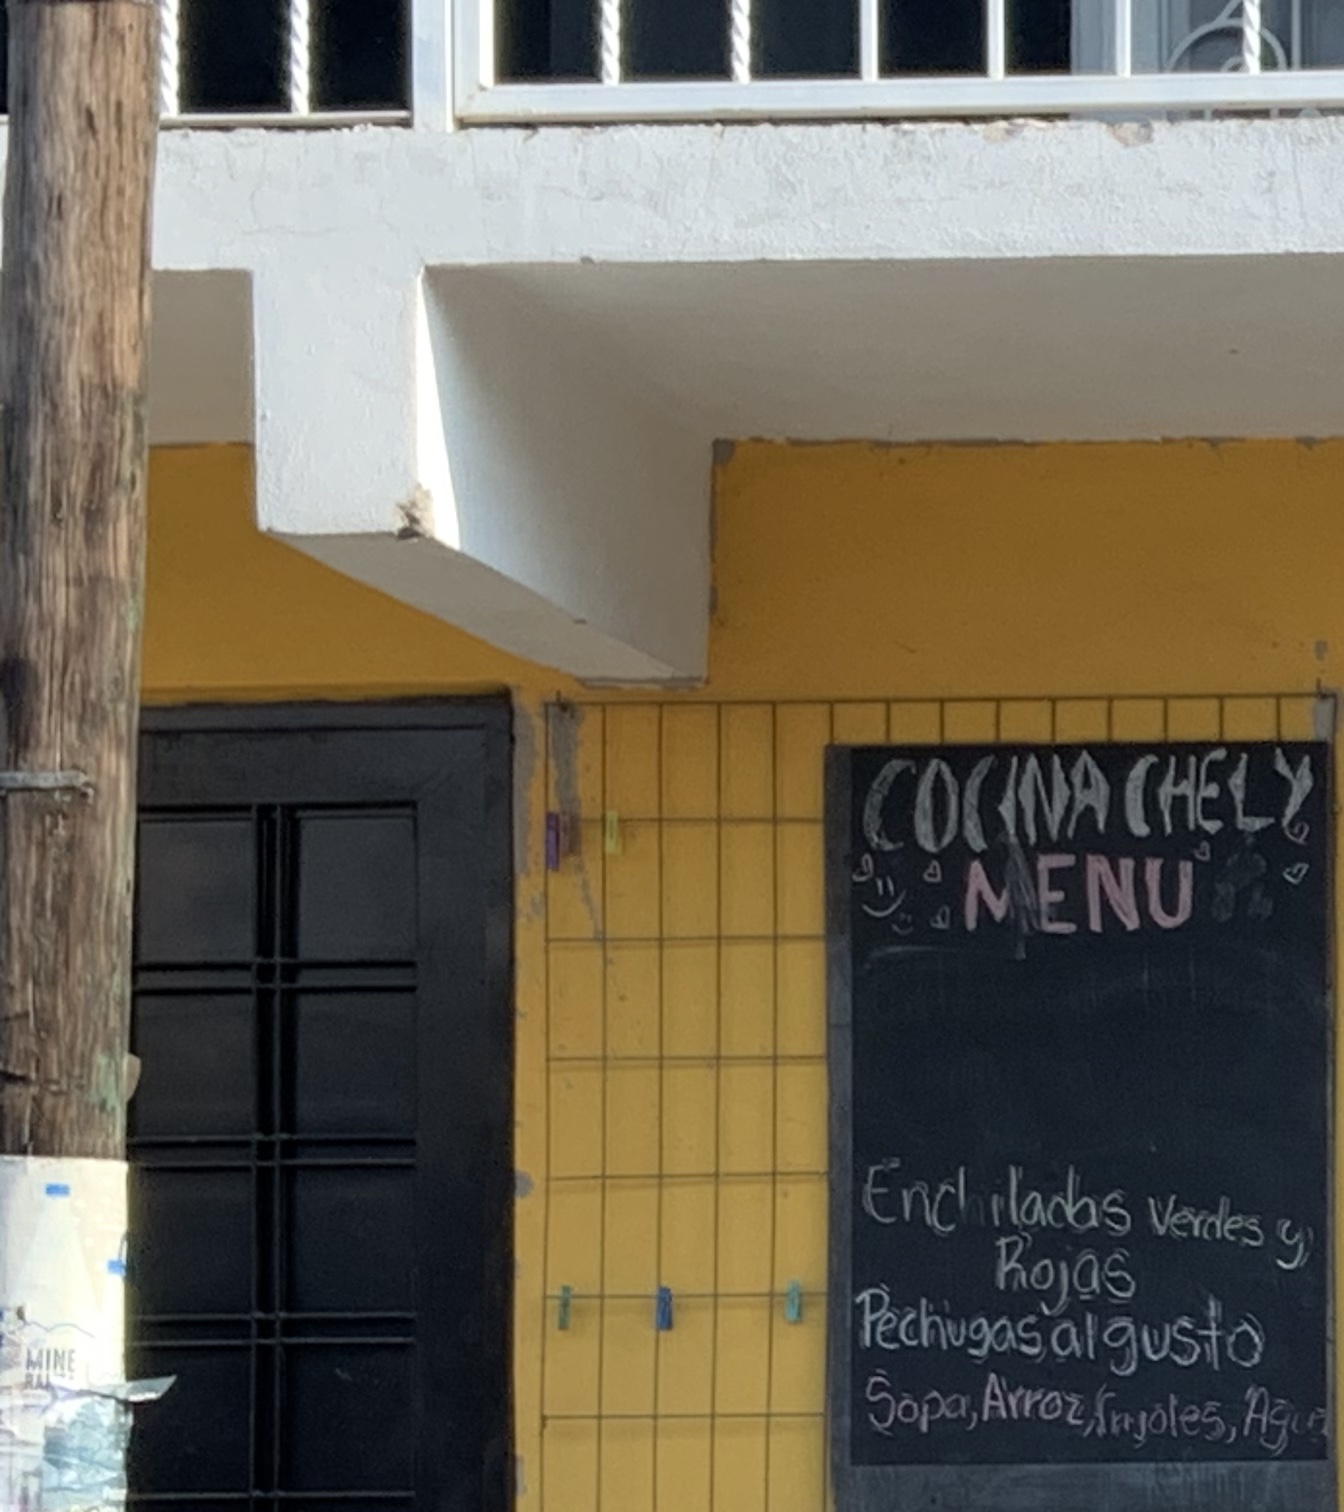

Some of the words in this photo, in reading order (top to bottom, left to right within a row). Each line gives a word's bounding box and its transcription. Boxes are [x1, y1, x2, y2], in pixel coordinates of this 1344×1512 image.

[863, 750, 1110, 852] COCINA
[1125, 748, 1314, 837] CHELY
[964, 853, 1193, 933] MENU
[996, 1232, 1136, 1315] Rojas
[1277, 1217, 1313, 1271] y
[27, 1348, 76, 1372] MINE
[856, 1282, 1042, 1363] Pechugas
[1052, 1312, 1097, 1363] al
[1103, 1295, 1265, 1376] gusto
